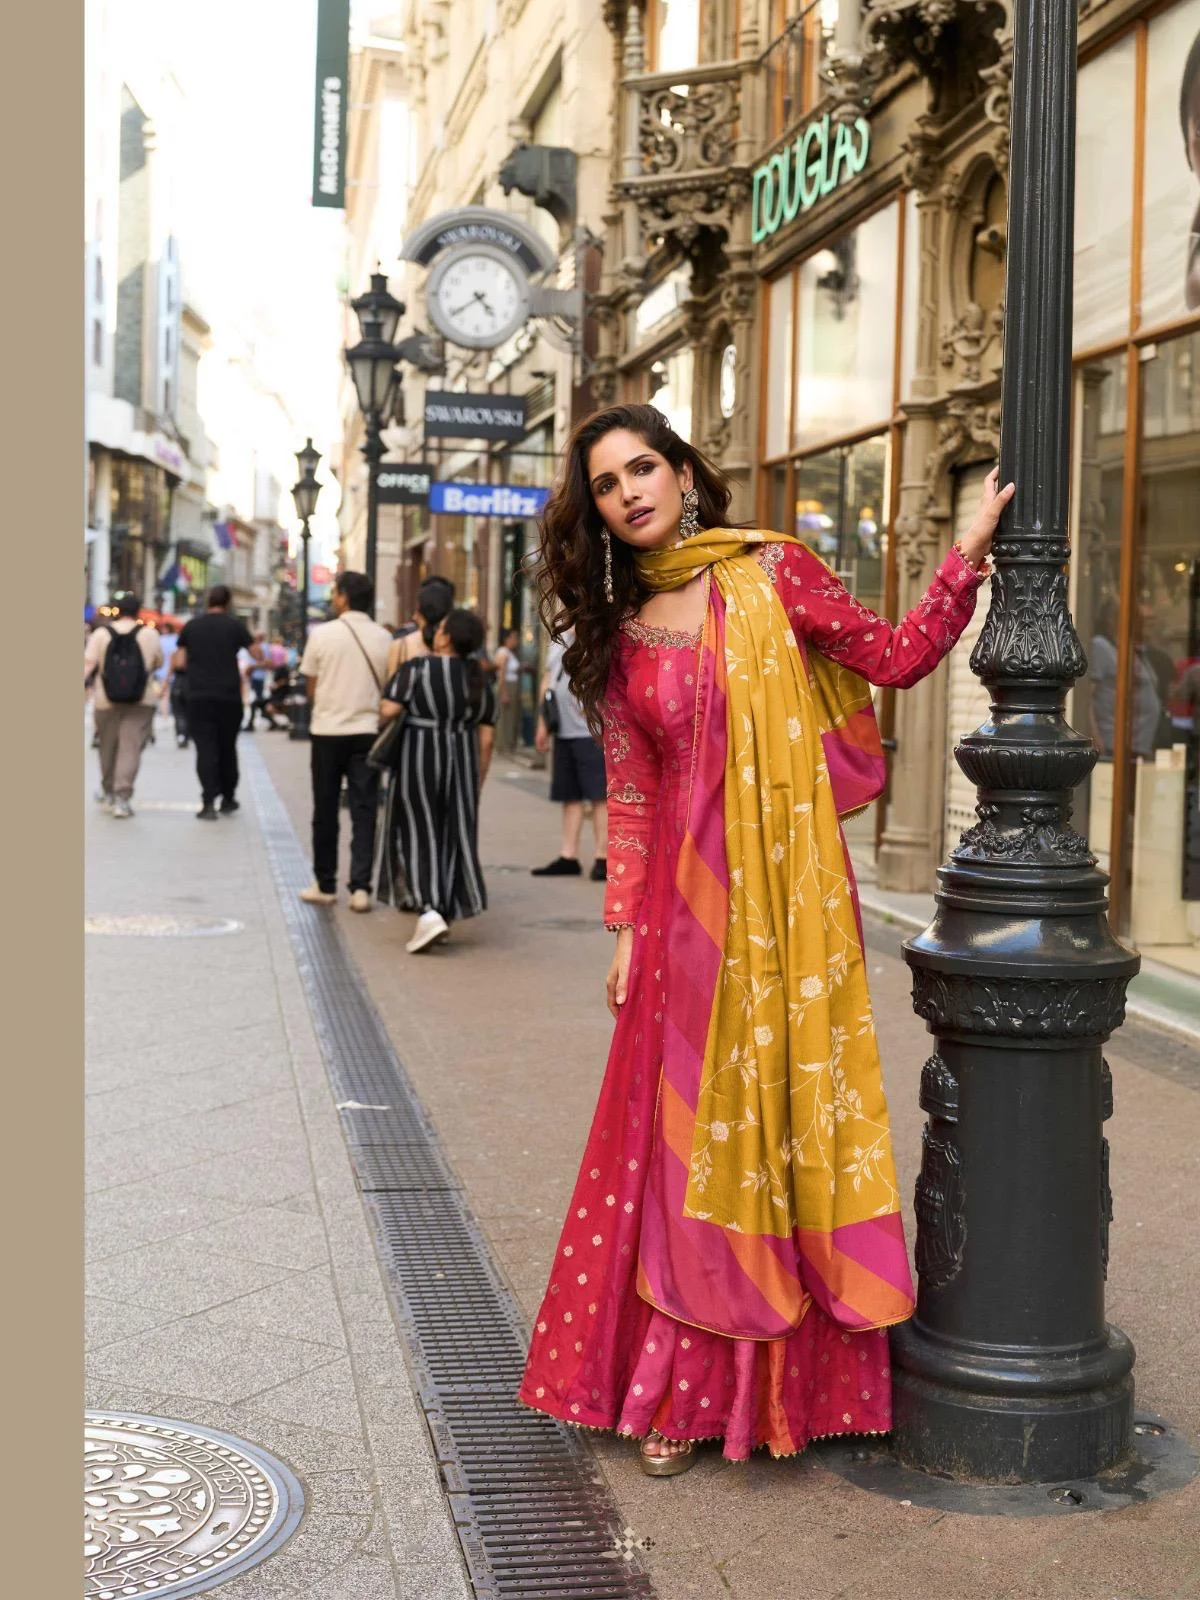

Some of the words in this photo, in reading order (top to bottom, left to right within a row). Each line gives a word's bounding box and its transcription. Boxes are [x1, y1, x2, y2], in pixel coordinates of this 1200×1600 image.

[318, 76, 341, 195] McDonald's
[751, 99, 870, 243] DOUGLAS
[425, 404, 524, 427] SWAROVSKI
[376, 472, 430, 488] OFFICE
[443, 486, 537, 516] Berlitz
[159, 1441, 247, 1506] BUDAPESTI
